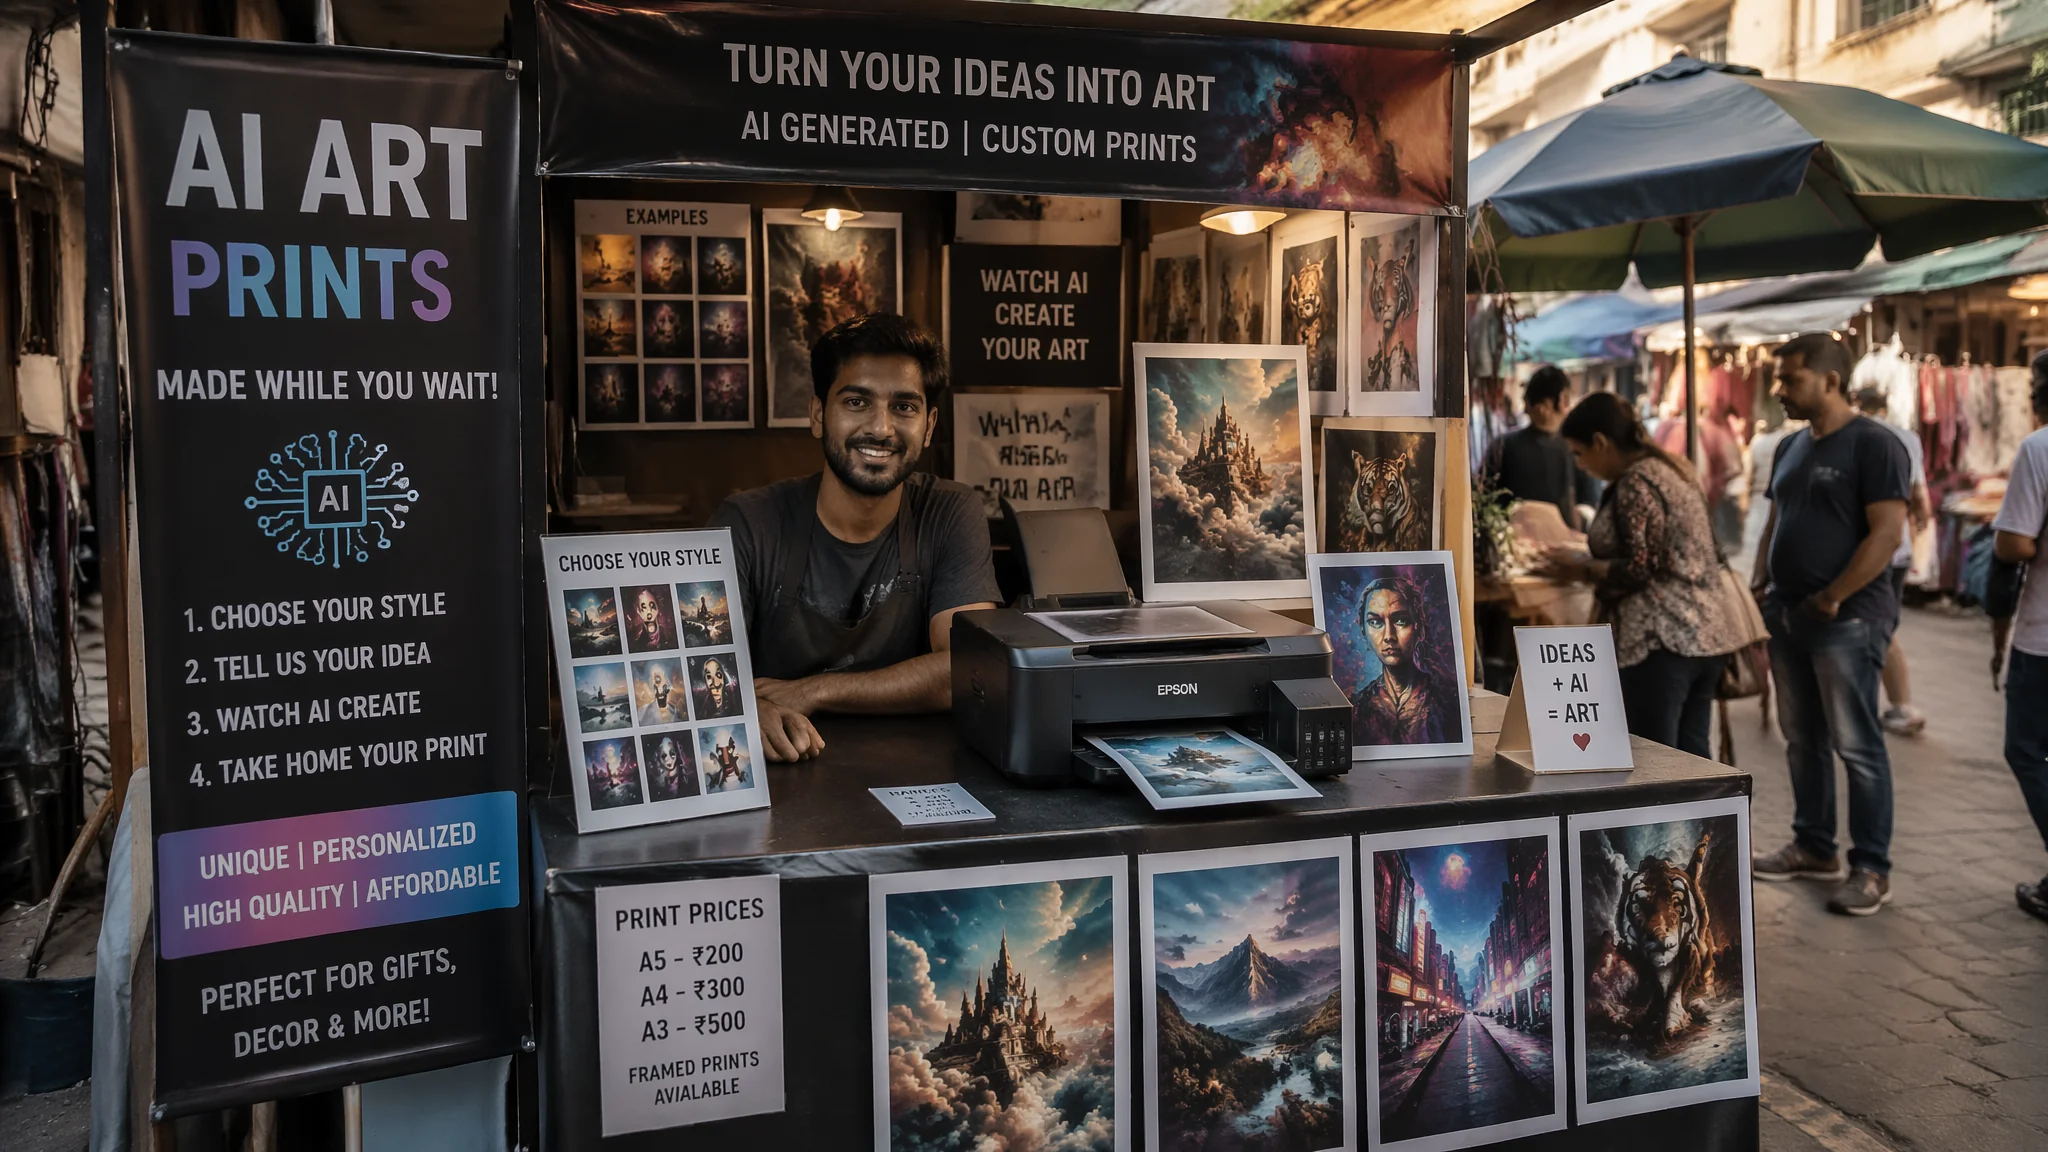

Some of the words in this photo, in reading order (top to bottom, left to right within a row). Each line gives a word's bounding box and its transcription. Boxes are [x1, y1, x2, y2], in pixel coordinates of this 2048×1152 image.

[723, 43, 828, 87] TURN
[840, 50, 941, 94] YOUR
[953, 57, 1055, 100] IDEAS
[1065, 65, 1142, 106] INTO
[1153, 73, 1216, 111] ART
[741, 110, 769, 141] AI
[780, 113, 949, 150] GENERATED
[982, 124, 1095, 157] CUSTOM
[1105, 131, 1197, 163] PRINTS
[166, 109, 264, 209] AI
[300, 119, 483, 220] ART
[626, 208, 708, 225] EXAMPLES
[170, 240, 452, 322] PRINTS
[980, 269, 1059, 294] WATCH
[1066, 271, 1088, 294] AI
[995, 303, 1075, 327] CREATE
[982, 337, 1040, 360] YOUR
[1048, 338, 1089, 361] ART
[157, 369, 246, 400] MADE
[255, 370, 348, 400] WHILE
[357, 371, 414, 399] YOU
[422, 372, 498, 400] WAIT!
[318, 485, 349, 512] AI
[559, 553, 624, 572] CHOOSE
[628, 550, 671, 568] YOUR
[676, 548, 721, 566] STYLE
[183, 608, 203, 632] 1.
[211, 601, 306, 630] CHOOSE
[313, 596, 374, 623] YOUR
[380, 592, 446, 618] STYLE
[185, 659, 206, 684] 2.
[214, 654, 269, 681] TELL
[276, 651, 306, 675] US
[313, 646, 375, 672] YOUR
[382, 642, 431, 667] IDEA
[1540, 643, 1595, 663] IDEAS
[1158, 683, 1197, 695] EPSON
[1571, 673, 1588, 692] AI
[187, 712, 209, 736] 3.
[216, 702, 300, 733] WATCH
[308, 699, 330, 724] AI
[337, 691, 421, 720] CREATE
[1565, 703, 1599, 723] ART
[189, 763, 211, 787] 4.
[219, 755, 278, 785] TAKE
[286, 747, 352, 777] HOME
[358, 740, 418, 768] YOUR
[425, 733, 487, 760] PRINT
[200, 845, 288, 879] UNIQUE
[312, 821, 477, 865] PERSONALIZED
[183, 898, 241, 929] HIGH
[249, 884, 345, 921] QUALITY
[366, 862, 501, 903] AFFORDABLE
[616, 905, 680, 931] PRINT
[689, 898, 764, 924] PRICES
[639, 950, 666, 972] A5
[693, 942, 743, 966] ₹200
[201, 969, 317, 1014] PERFECT
[325, 959, 375, 991] FOR
[382, 947, 457, 981] GIFTS,
[641, 984, 668, 1007] A4
[694, 976, 744, 1000] ₹300
[234, 1017, 319, 1058] DECOR
[327, 1014, 345, 1038] &
[353, 998, 430, 1033] MORE!
[642, 1019, 668, 1042] A3
[695, 1010, 745, 1035] ₹500
[629, 1060, 695, 1084] FRAMED
[702, 1051, 759, 1073] PRINTS
[655, 1078, 740, 1105] AVIALABLE
